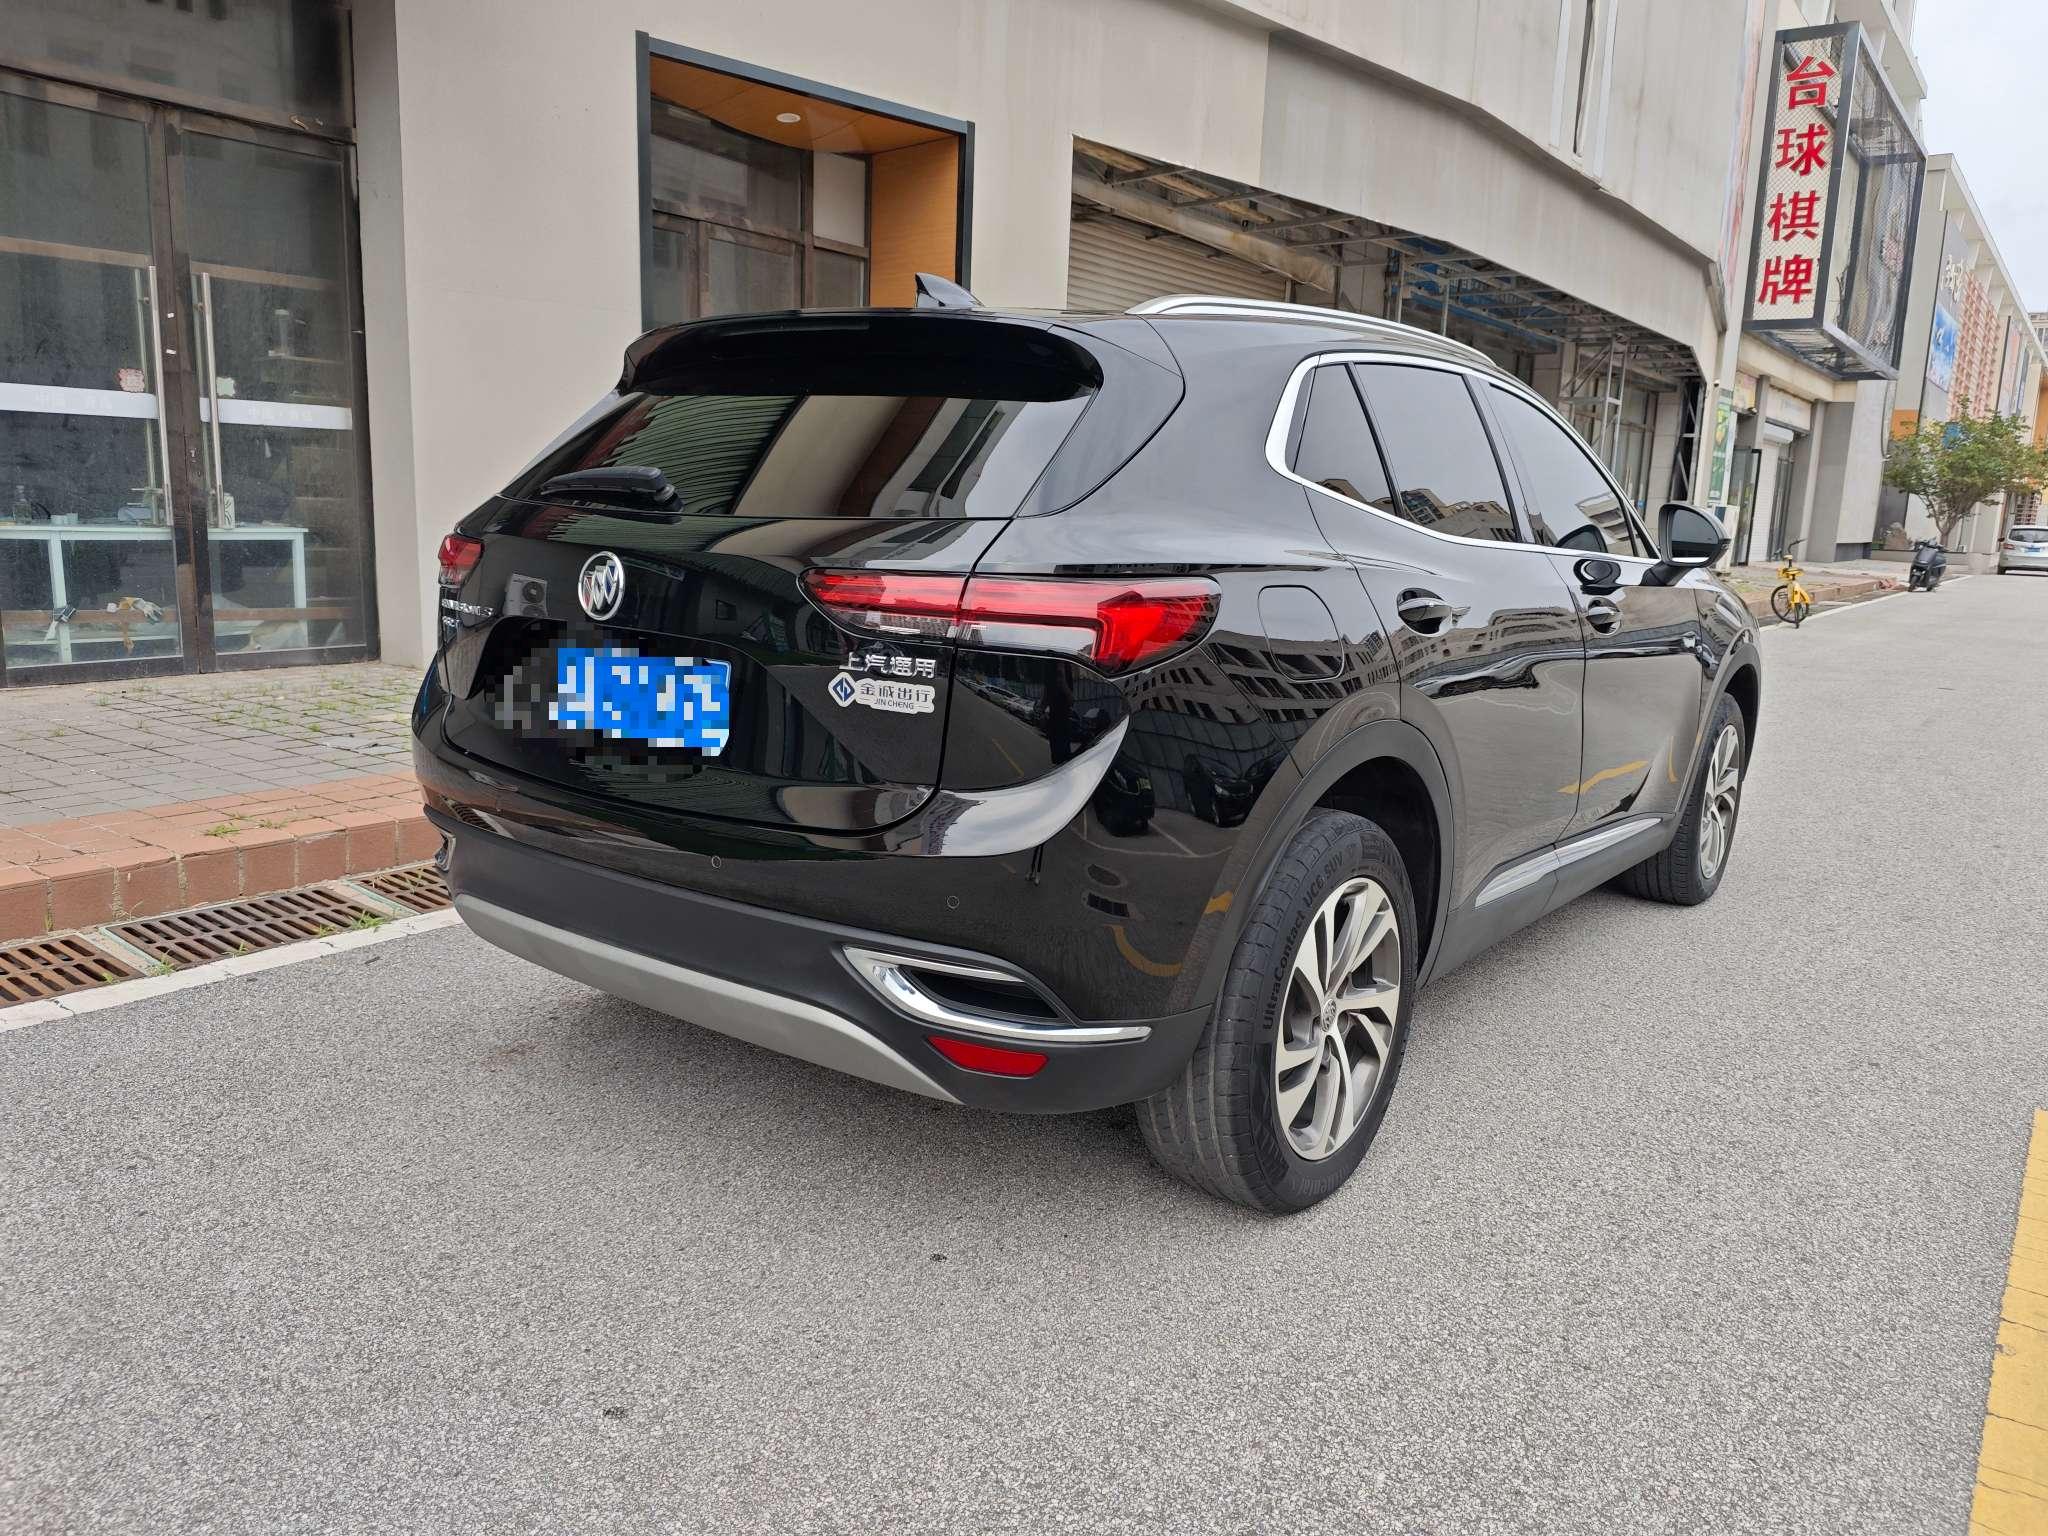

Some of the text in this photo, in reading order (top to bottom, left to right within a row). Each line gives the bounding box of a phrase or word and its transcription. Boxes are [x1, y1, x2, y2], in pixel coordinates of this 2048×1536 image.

[1758, 55, 1837, 306] 台球棋牌
[839, 651, 936, 678] 上汽通用
[874, 698, 914, 710] JIN CHENG
